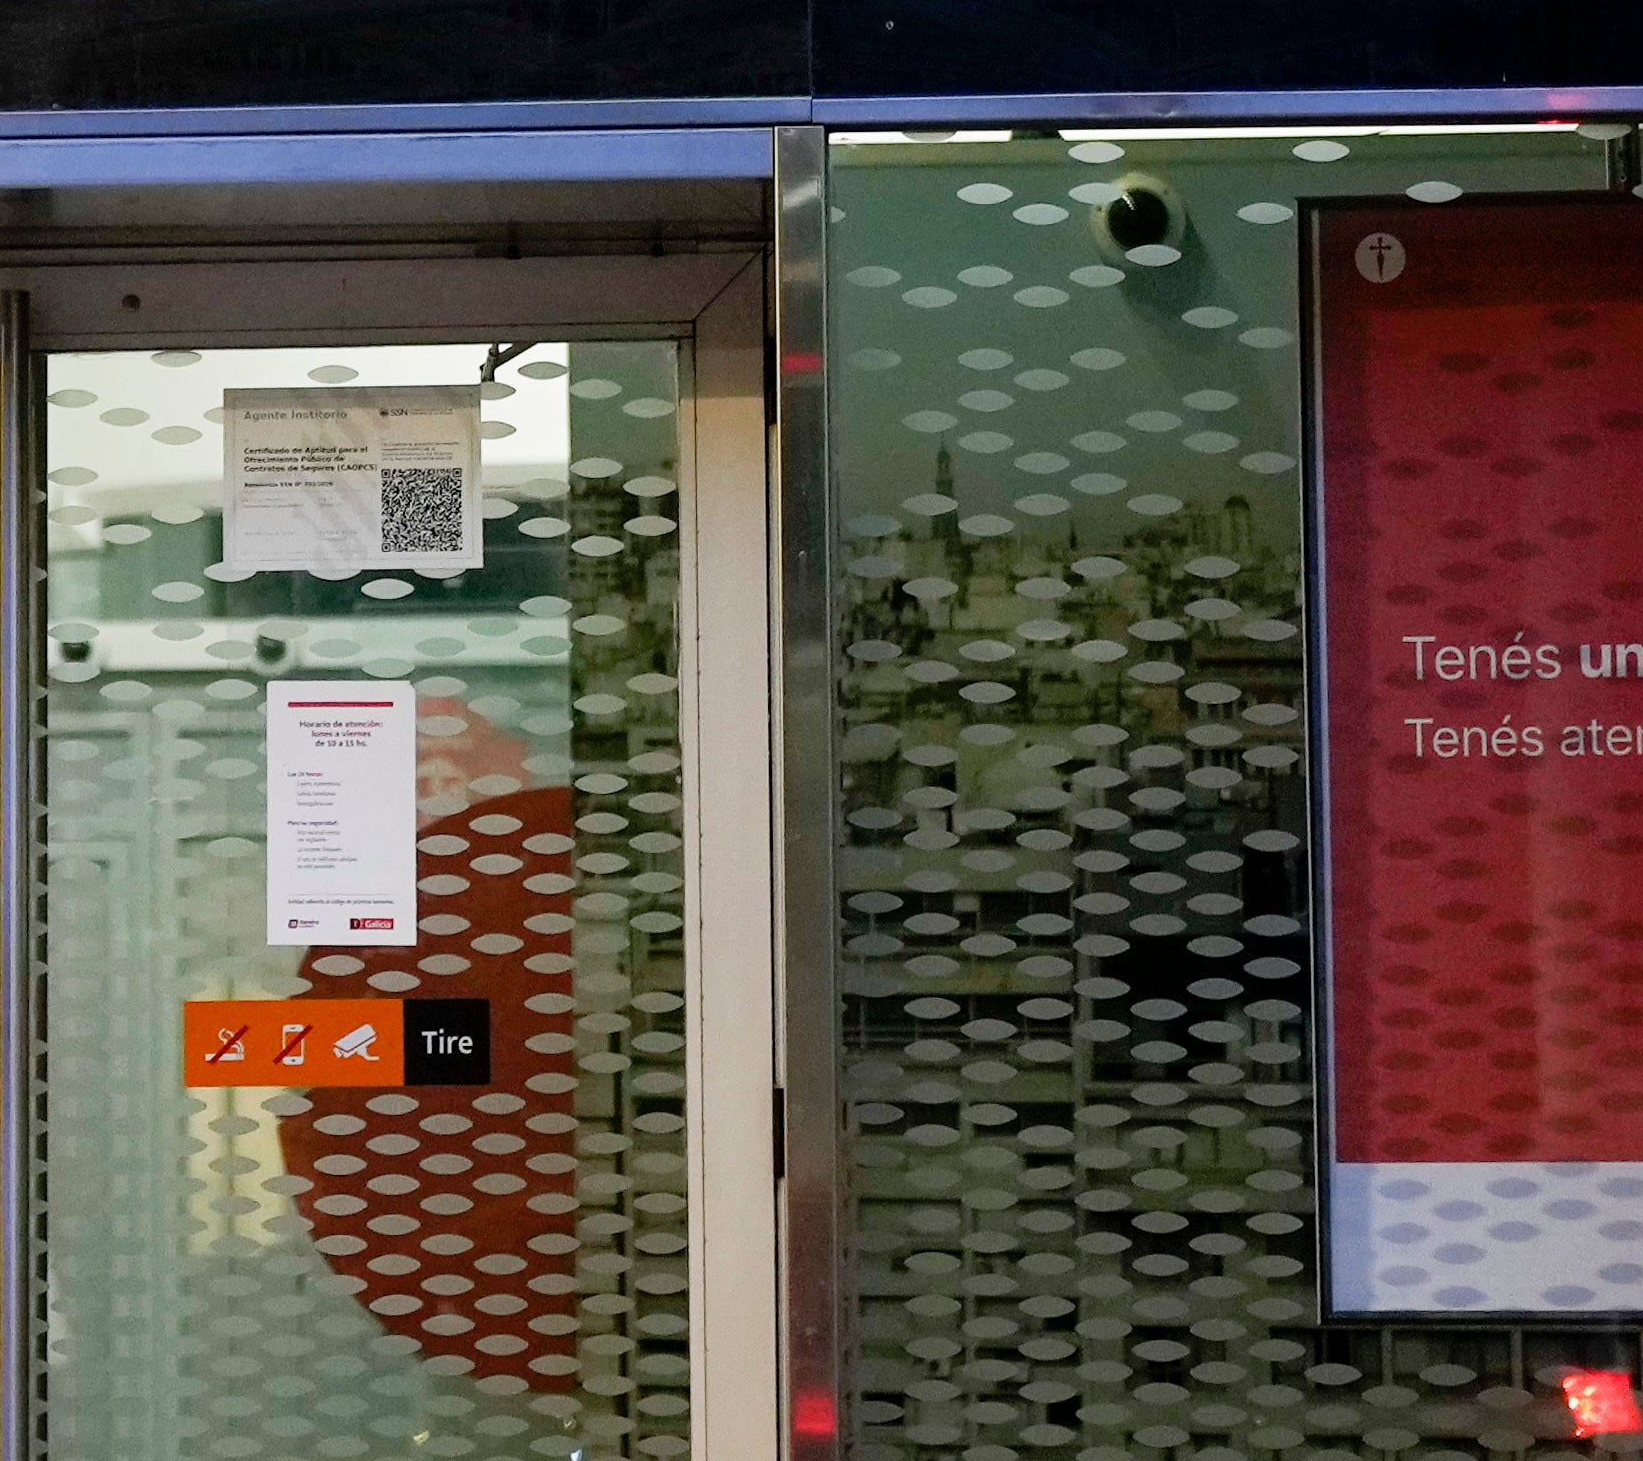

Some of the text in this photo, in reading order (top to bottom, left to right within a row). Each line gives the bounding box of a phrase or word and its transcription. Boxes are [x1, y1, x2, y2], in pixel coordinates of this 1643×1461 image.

[244, 410, 348, 422] Agente Institorio
[390, 408, 408, 416] SSN
[1401, 635, 1561, 681] Tenés
[1405, 717, 1543, 758] Tenés
[364, 920, 392, 929] Galicia
[422, 1030, 474, 1055] Tire
